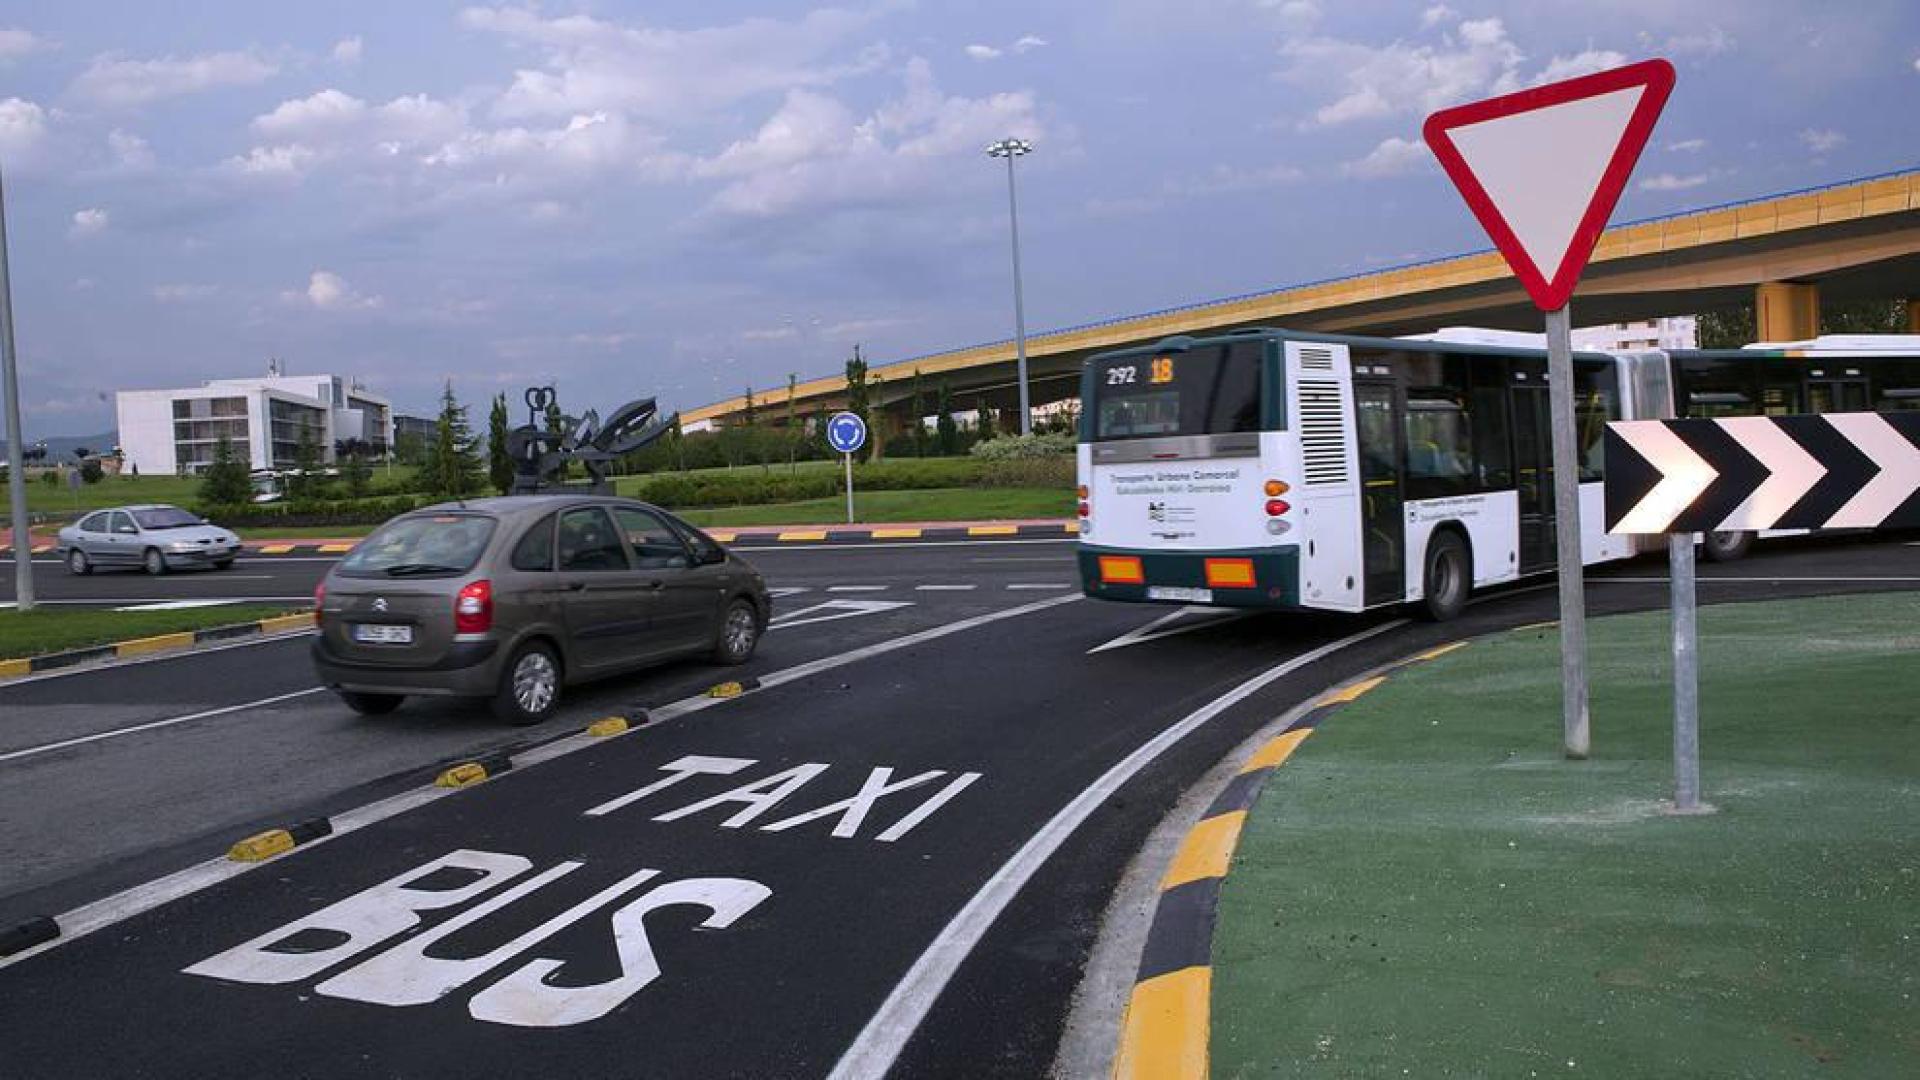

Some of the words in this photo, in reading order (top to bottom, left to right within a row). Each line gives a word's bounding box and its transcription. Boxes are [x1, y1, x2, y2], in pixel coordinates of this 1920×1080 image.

[1106, 366, 1137, 385] 292
[1151, 358, 1174, 383] 18
[584, 755, 983, 842] TAXI
[181, 848, 773, 1027] BUS
